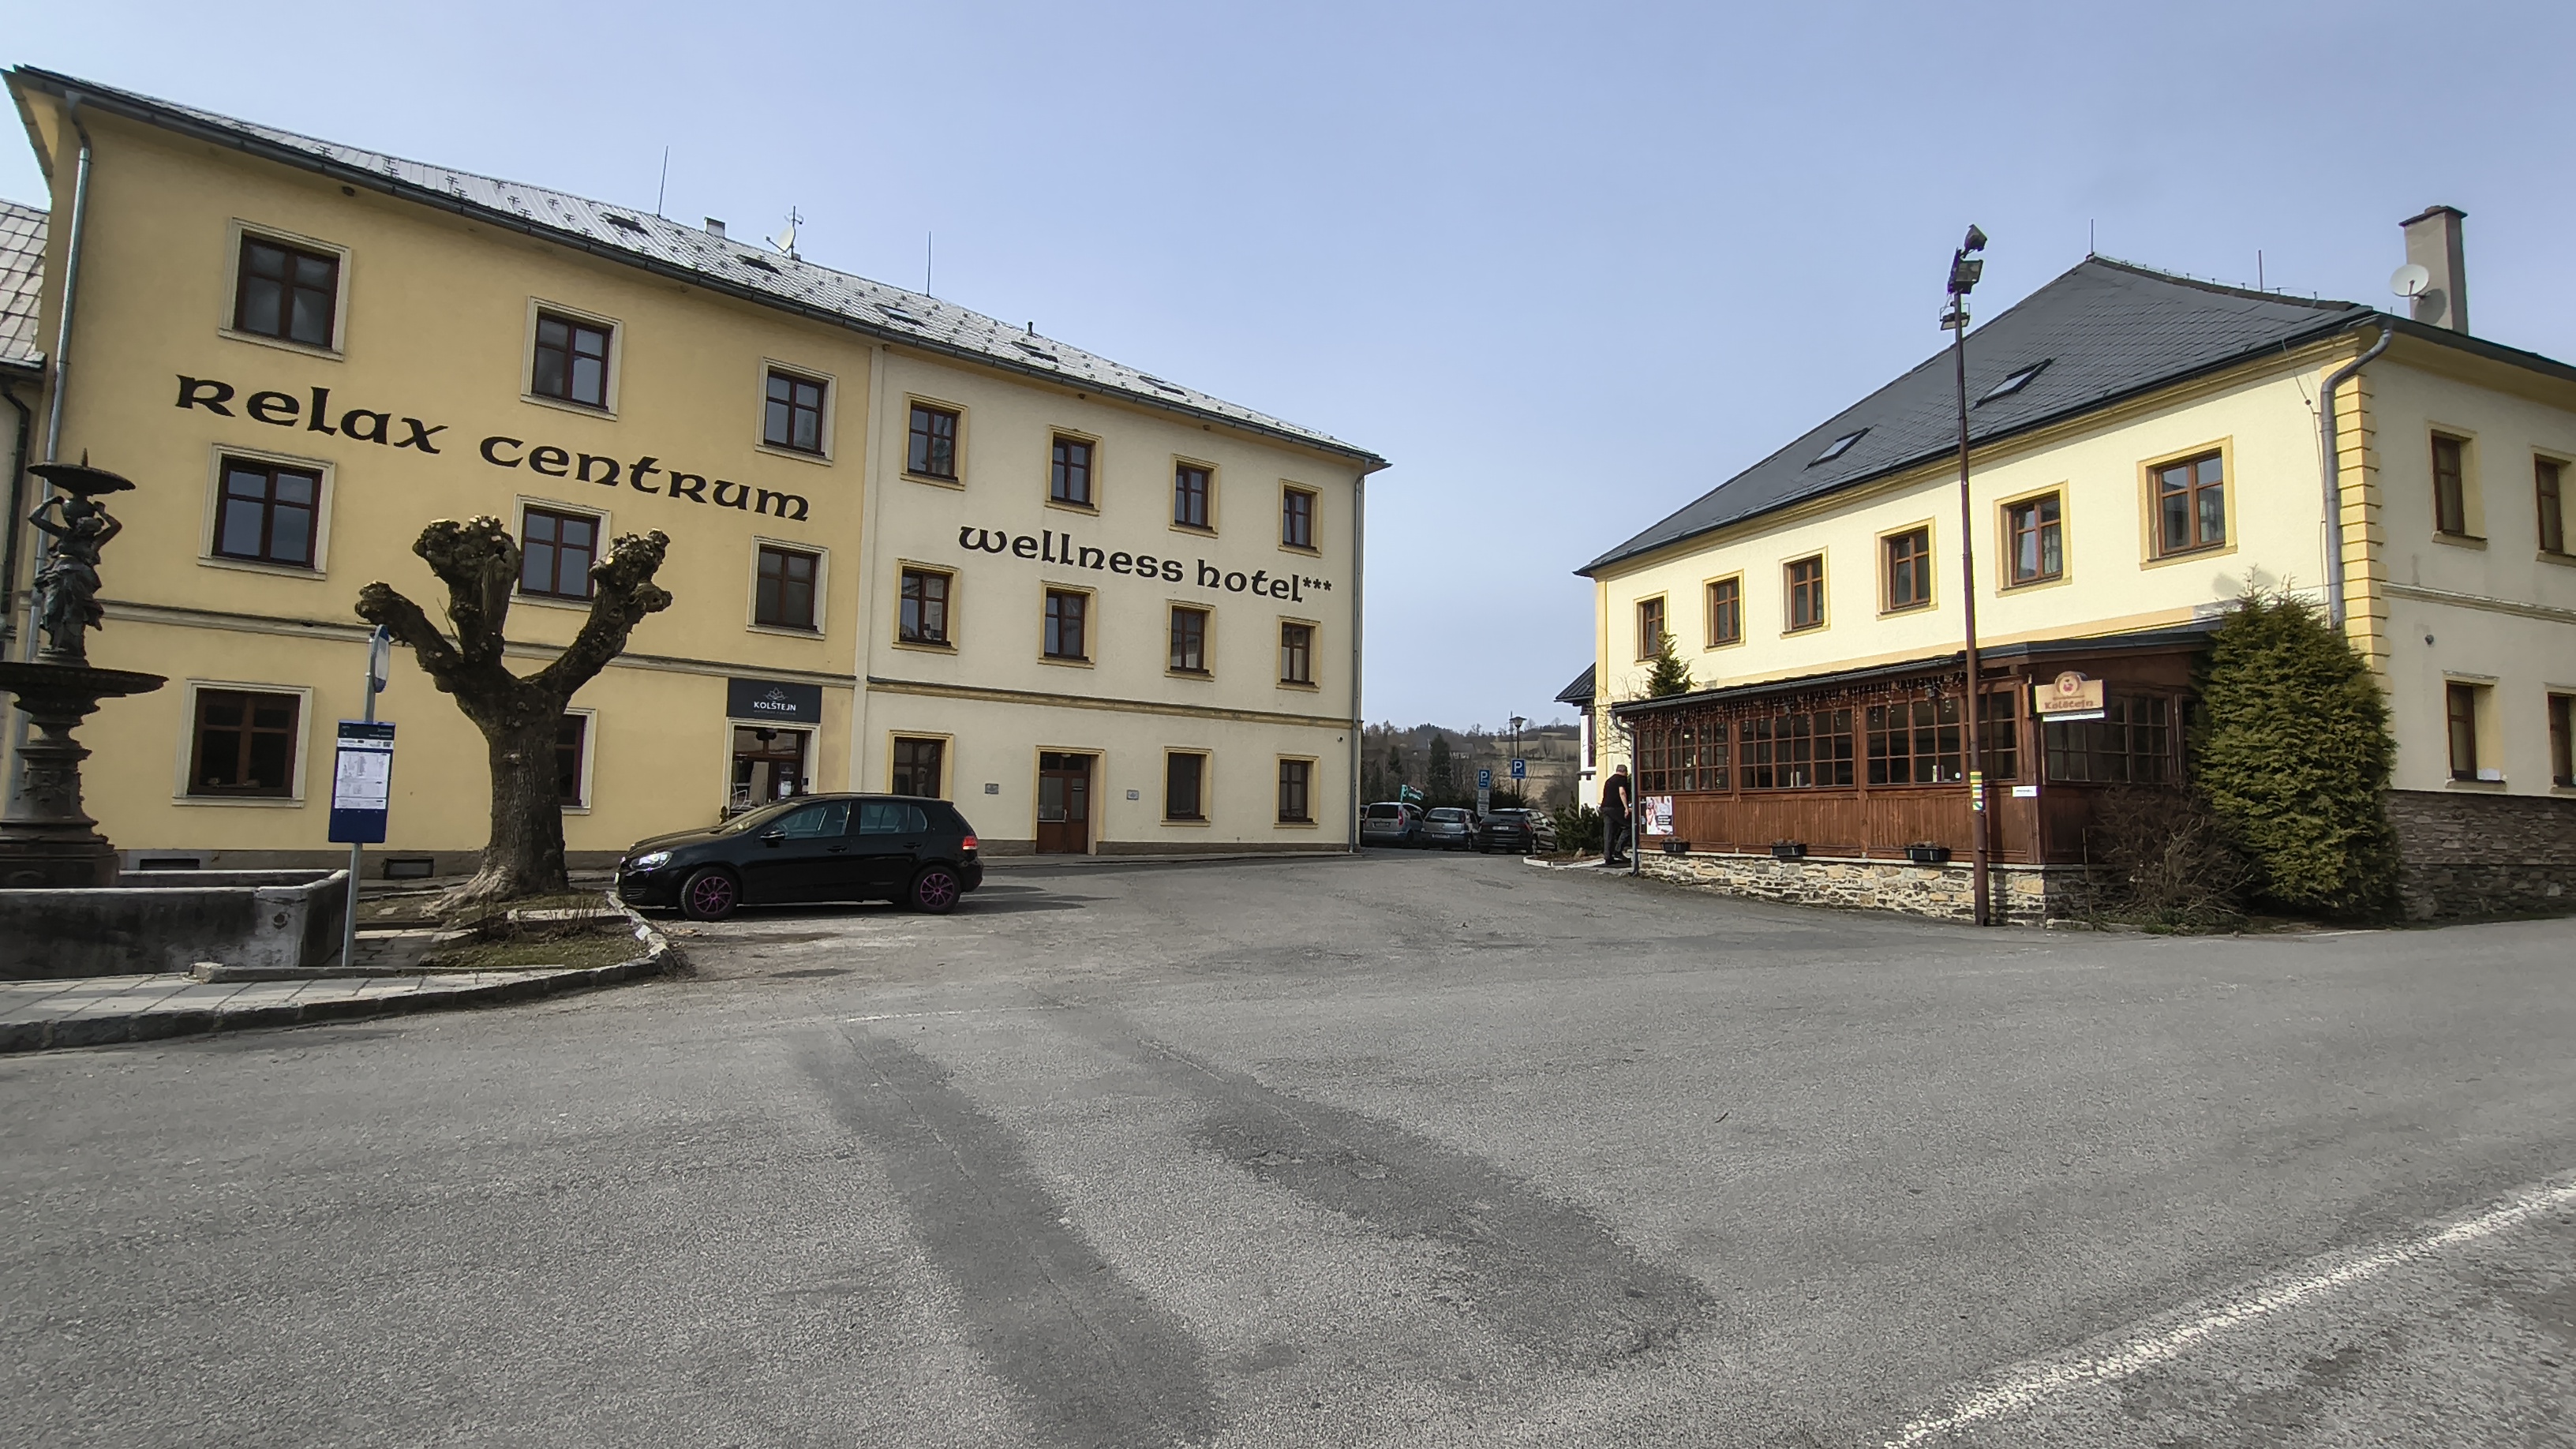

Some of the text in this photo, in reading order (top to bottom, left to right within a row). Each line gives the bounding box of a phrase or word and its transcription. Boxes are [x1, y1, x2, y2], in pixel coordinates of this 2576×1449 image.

[175, 374, 810, 522] Relax centrum
[958, 526, 1184, 582] wellness
[754, 700, 796, 711] KOLŠTEJN
[1514, 761, 1522, 773] P
[1480, 770, 1488, 782] P
